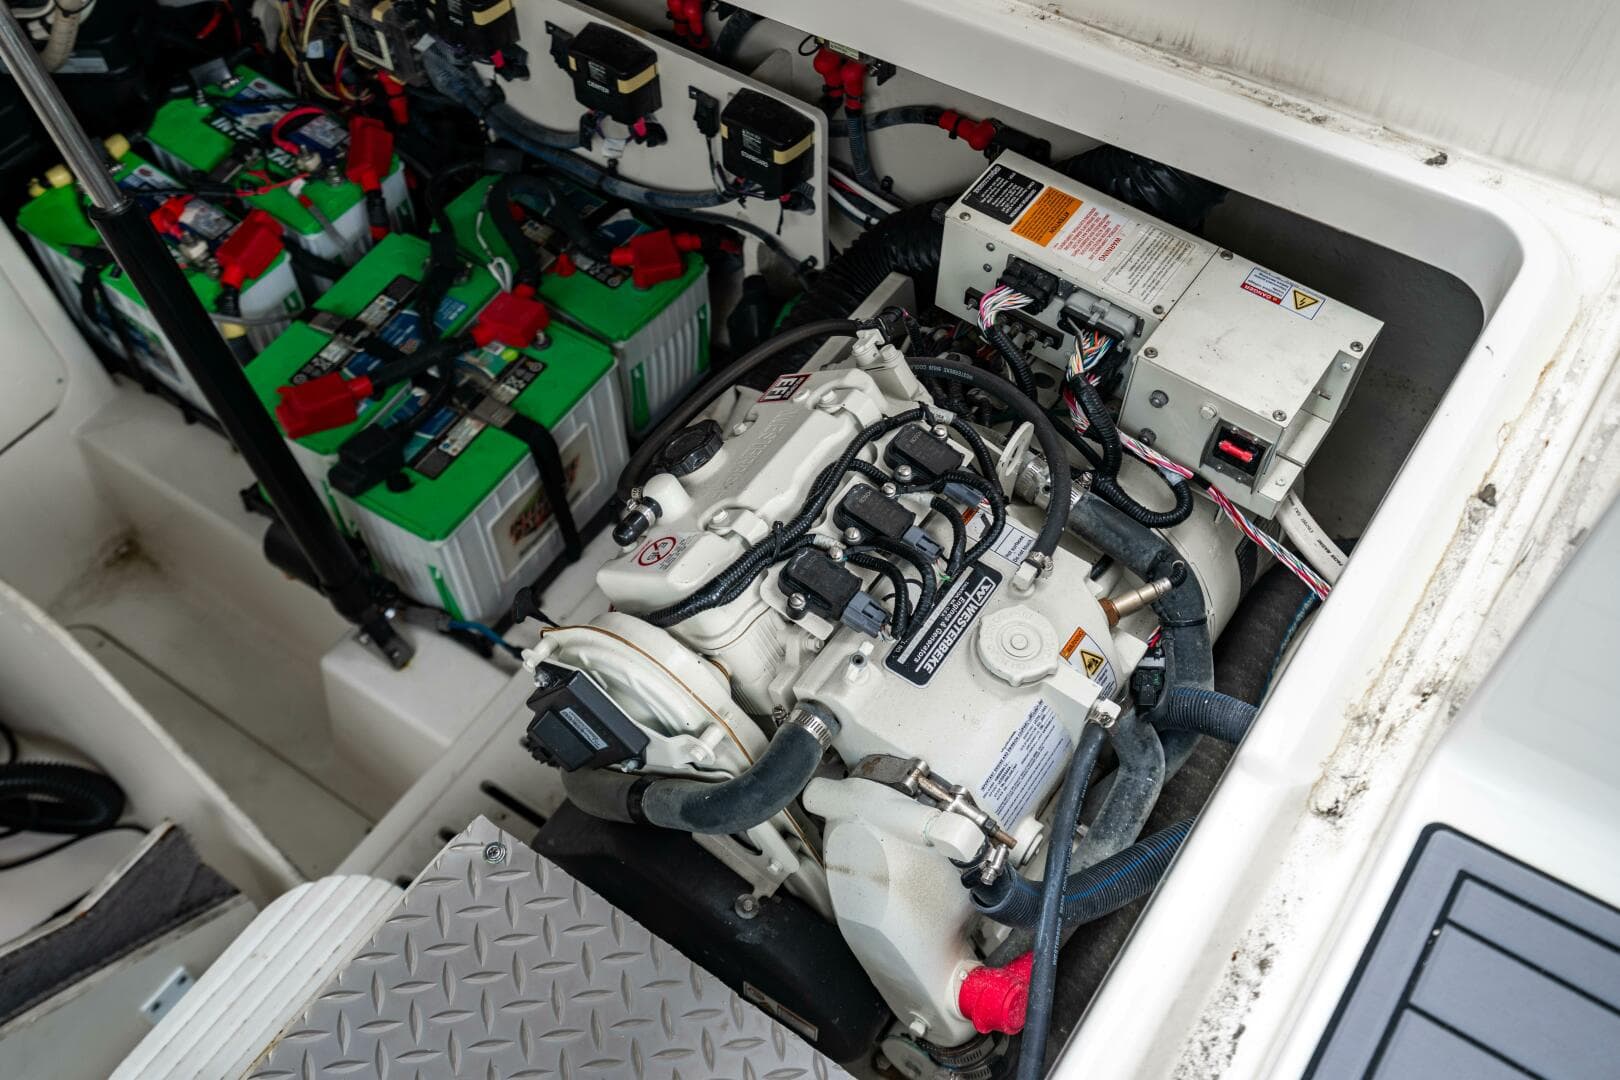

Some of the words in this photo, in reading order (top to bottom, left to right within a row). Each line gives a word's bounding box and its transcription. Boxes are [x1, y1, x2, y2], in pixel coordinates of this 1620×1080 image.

[1048, 210, 1069, 234] ATTENTION
[1097, 235, 1122, 263] WARNING
[1244, 284, 1272, 299] DANGER
[764, 378, 797, 398] EFI
[943, 595, 965, 622] Engines
[939, 620, 947, 628] &
[912, 627, 942, 664] Generators
[921, 602, 978, 673] WESTERBEKE
